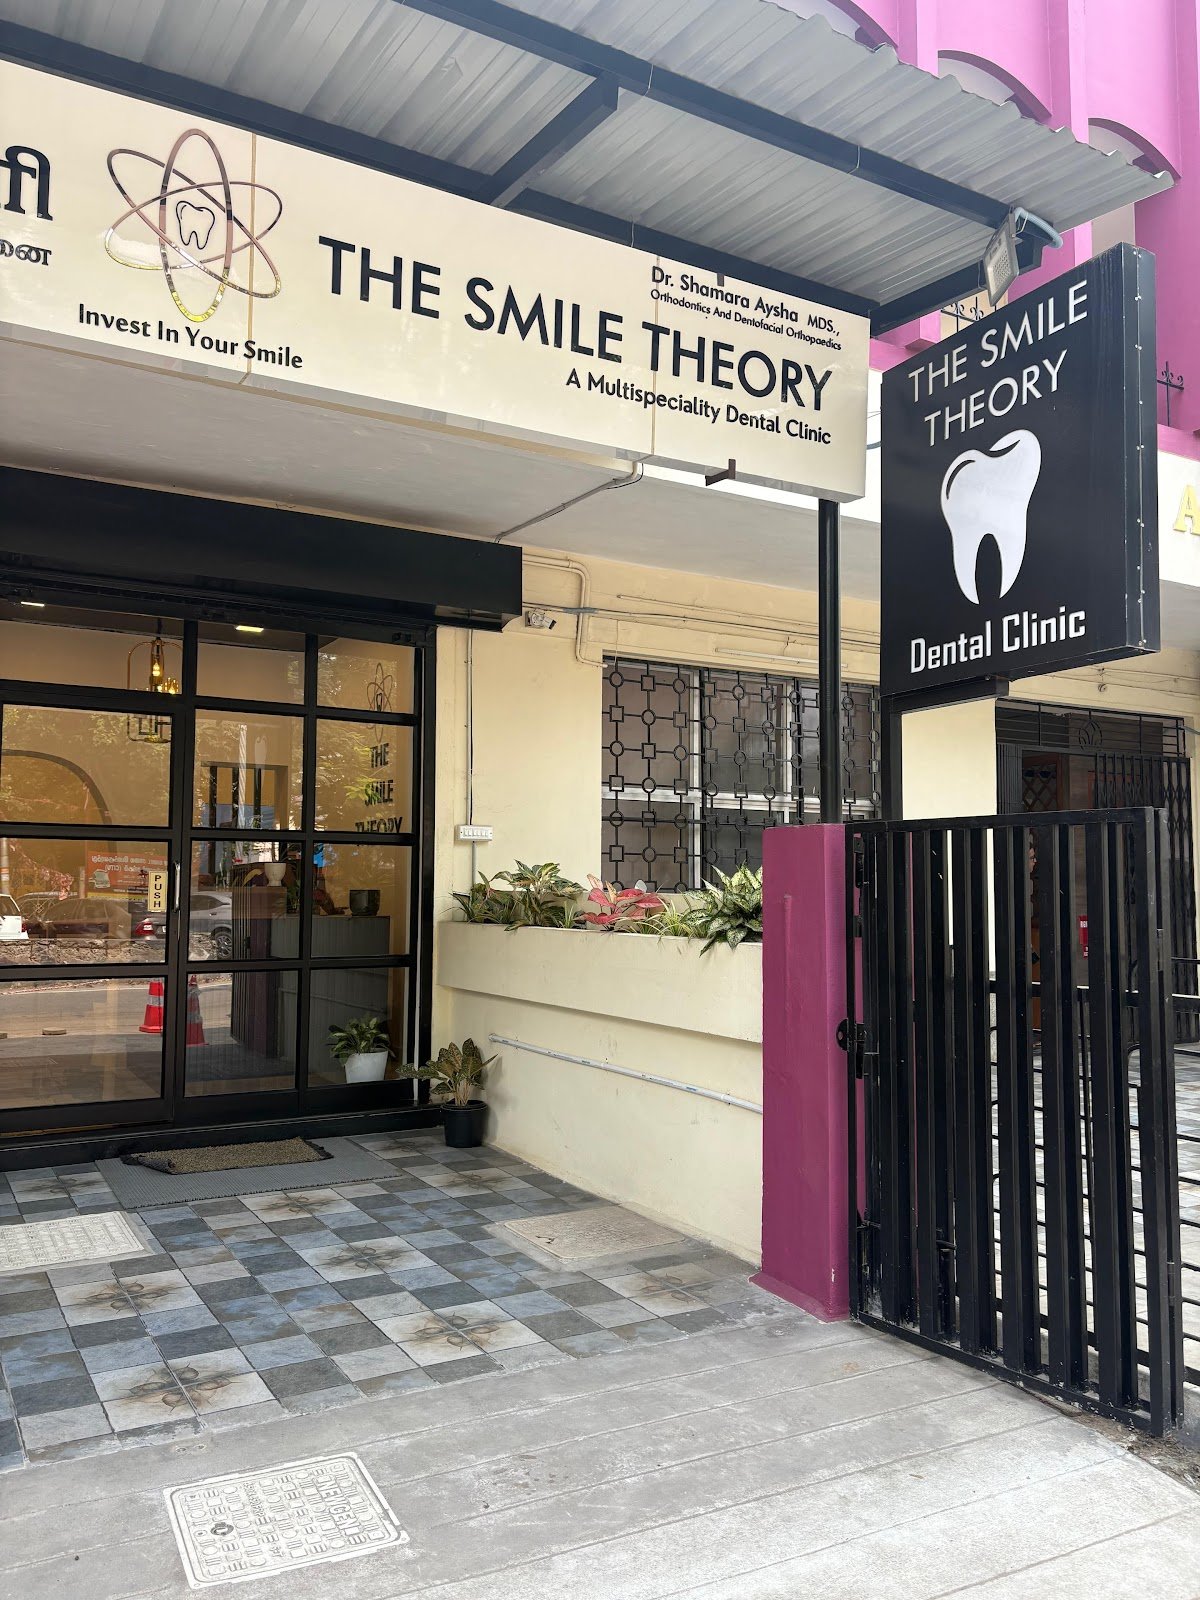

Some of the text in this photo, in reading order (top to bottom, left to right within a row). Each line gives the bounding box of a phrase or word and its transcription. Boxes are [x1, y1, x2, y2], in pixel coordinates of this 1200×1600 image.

[79, 303, 303, 369] Invest In Your Smile
[319, 235, 832, 411] THE SMILE THEORY
[650, 289, 842, 351] Orthodontics And Dentofacial Orthopaedics
[651, 265, 840, 337] Dr. Shamara Aysha MDS.,
[908, 279, 1088, 403] THE SMILE
[566, 368, 832, 445] A Multispeciality Dental Clinic
[924, 349, 1068, 447] THEORY
[910, 605, 1086, 674] Dental Clinic
[370, 742, 390, 769] THE
[153, 874, 162, 908] PUSH
